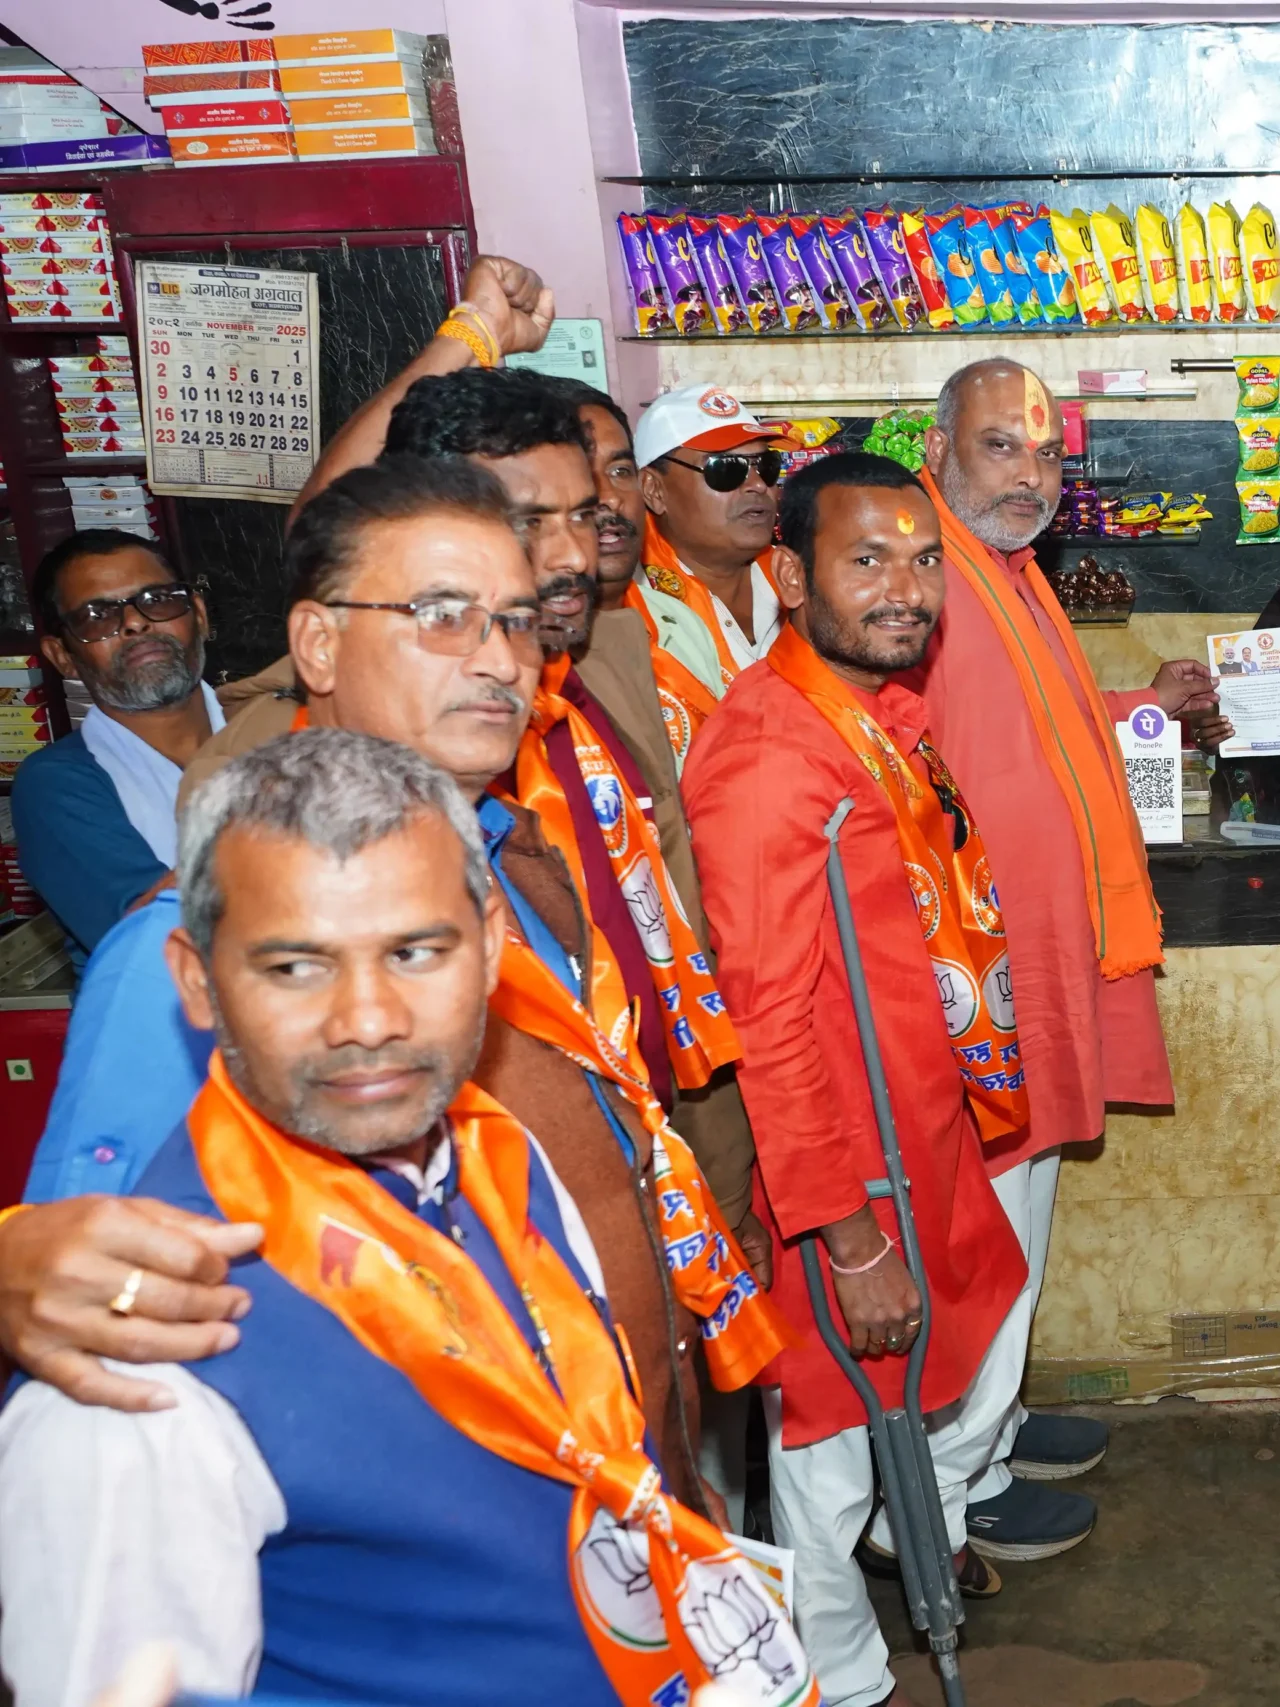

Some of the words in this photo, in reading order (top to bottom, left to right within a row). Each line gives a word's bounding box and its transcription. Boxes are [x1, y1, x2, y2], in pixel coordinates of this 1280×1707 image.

[161, 283, 180, 295] LIC
[190, 281, 250, 300] जगमोहन
[254, 288, 302, 303] अग्रवाल
[207, 322, 254, 332] NOVEMBER
[277, 325, 306, 336] 2025
[150, 341, 170, 355] 30
[294, 350, 299, 363] 1
[157, 363, 166, 377] 2
[183, 365, 191, 378] 3
[207, 366, 215, 379] 4
[230, 367, 237, 381] 5
[251, 369, 258, 383] 6
[272, 371, 279, 384] 7
[294, 372, 302, 386] 8
[158, 385, 167, 400] 9
[180, 387, 198, 400] 10
[204, 388, 220, 402] 11
[227, 389, 243, 403] 12
[249, 391, 263, 405] 13
[269, 393, 285, 407] 14
[291, 394, 307, 408] 15
[156, 407, 174, 421] 16
[181, 409, 198, 423] 17
[206, 410, 223, 423] 18
[229, 411, 244, 425] 19
[250, 413, 265, 427] 20
[270, 414, 284, 428] 21
[291, 416, 308, 430] 22
[156, 429, 175, 443] 23
[181, 430, 199, 444] 24
[206, 431, 224, 445] 25
[230, 433, 246, 447] 26
[251, 435, 265, 448] 27
[270, 436, 287, 450] 28
[292, 438, 308, 452] 29
[1140, 712, 1156, 734] पे
